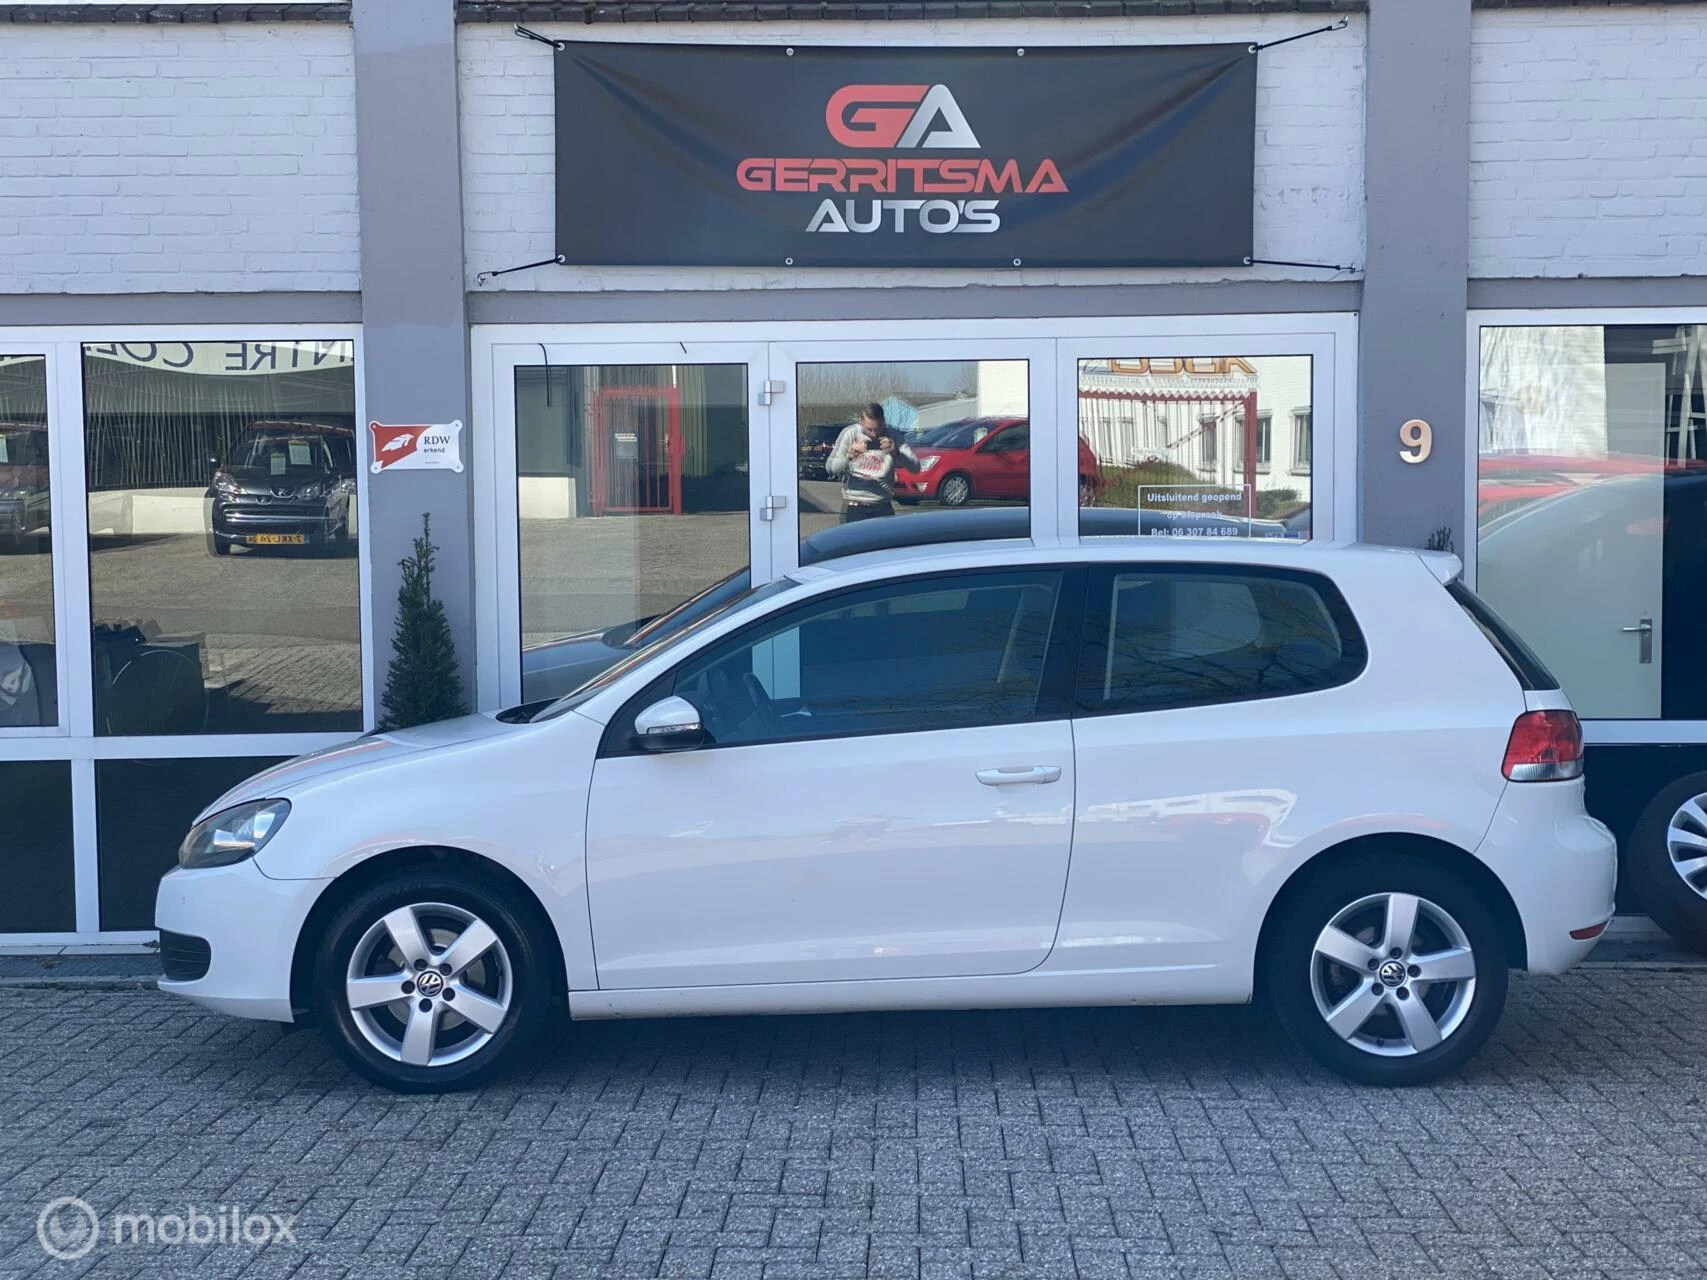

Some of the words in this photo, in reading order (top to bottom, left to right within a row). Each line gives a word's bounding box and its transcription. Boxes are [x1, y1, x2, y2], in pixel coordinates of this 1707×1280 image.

[825, 84, 981, 149] GA
[736, 157, 1069, 193] GERRITSMA
[805, 198, 1000, 233] AUTO'S
[423, 435, 451, 445] RDW
[1399, 419, 1432, 464] 9
[1147, 493, 1199, 502] Uitsluitend
[1201, 492, 1242, 503] geopend
[1172, 528, 1184, 536] 06
[1186, 528, 1203, 536] 307
[1206, 528, 1218, 536] 84
